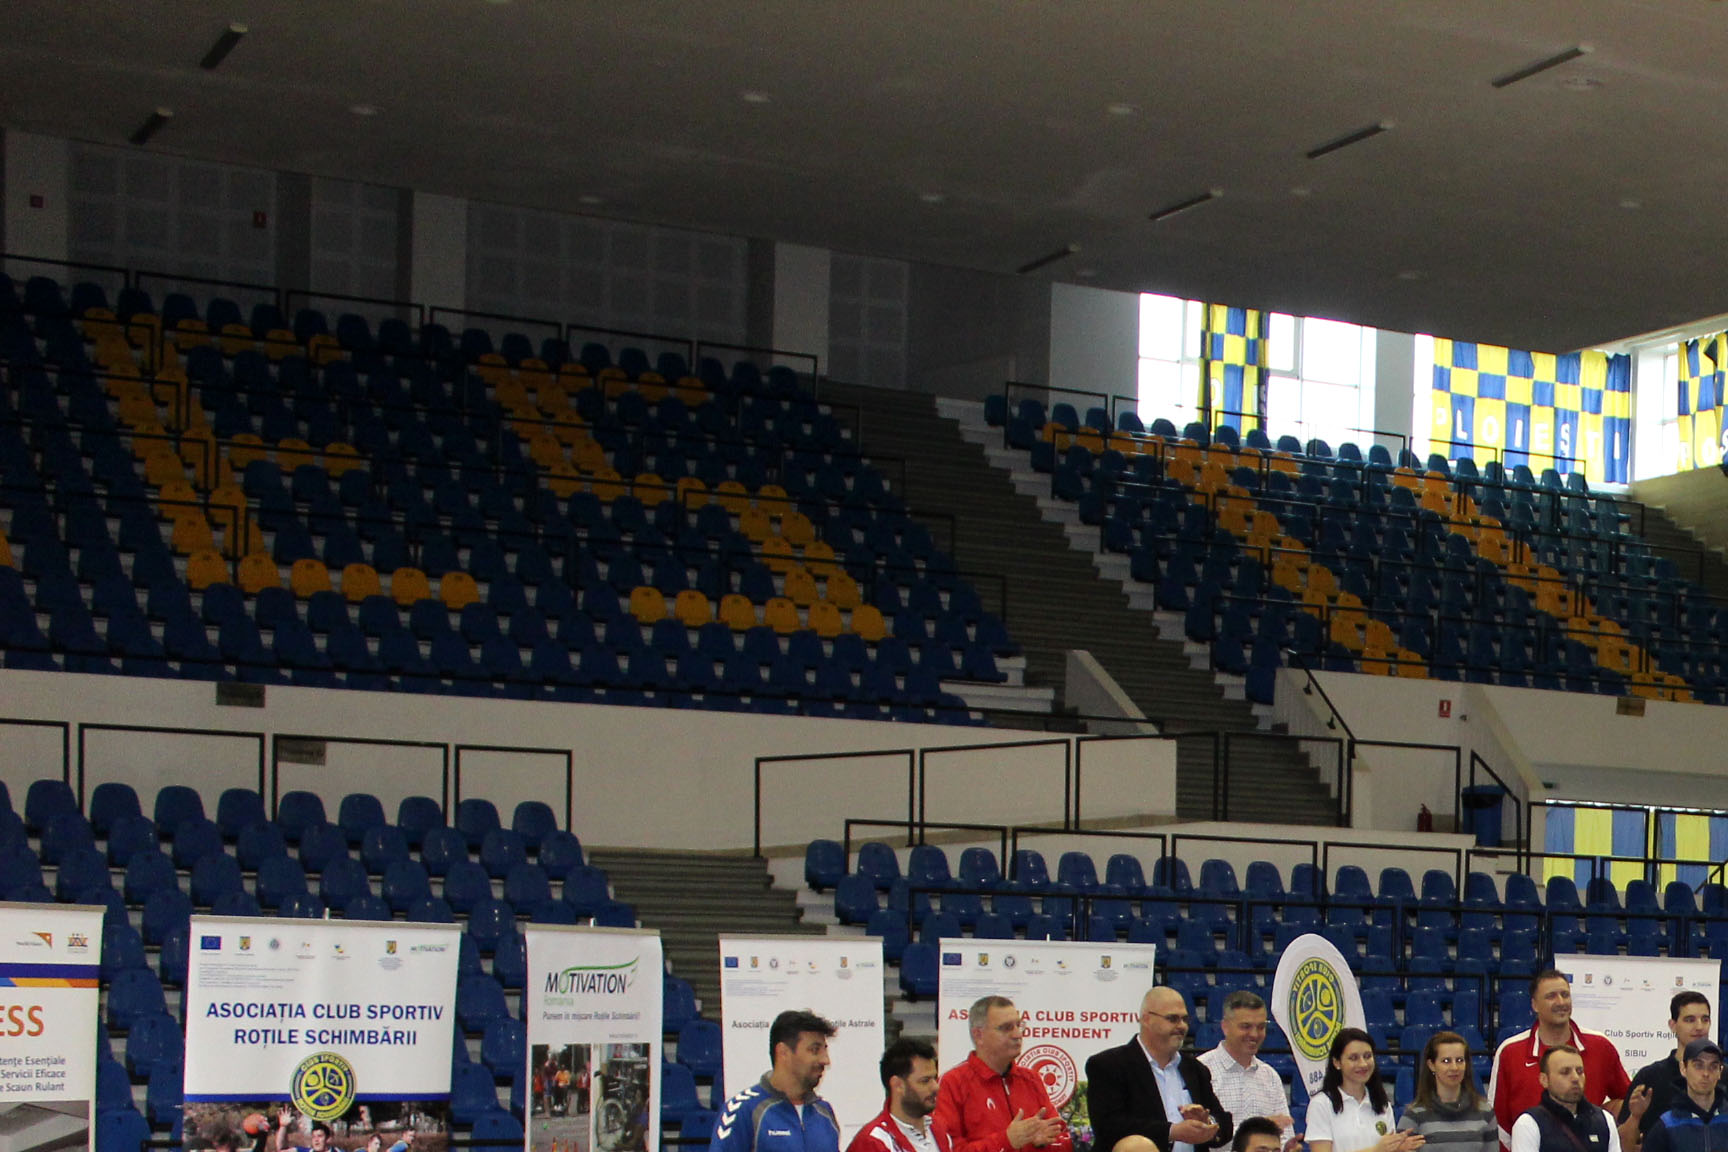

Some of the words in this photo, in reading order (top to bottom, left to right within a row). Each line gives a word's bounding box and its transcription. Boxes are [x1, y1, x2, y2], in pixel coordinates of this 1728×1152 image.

[545, 970, 628, 994] MOTIVATION
[312, 1003, 361, 1019] CLUB
[367, 1004, 444, 1020] SPORTIV
[1035, 1010, 1075, 1022] CLUB
[847, 1019, 875, 1028] Astrale
[304, 1026, 417, 1046] SCHIMBĂRII
[1022, 1027, 1111, 1040] DEPENDENT
[1604, 1029, 1623, 1038] Club
[1625, 1029, 1655, 1041] Sportiv
[1624, 1049, 1648, 1058] SIBIU
[35, 1069, 66, 1079] Eficace
[6, 1083, 33, 1092] Scaun
[35, 1082, 65, 1092] Rulant
